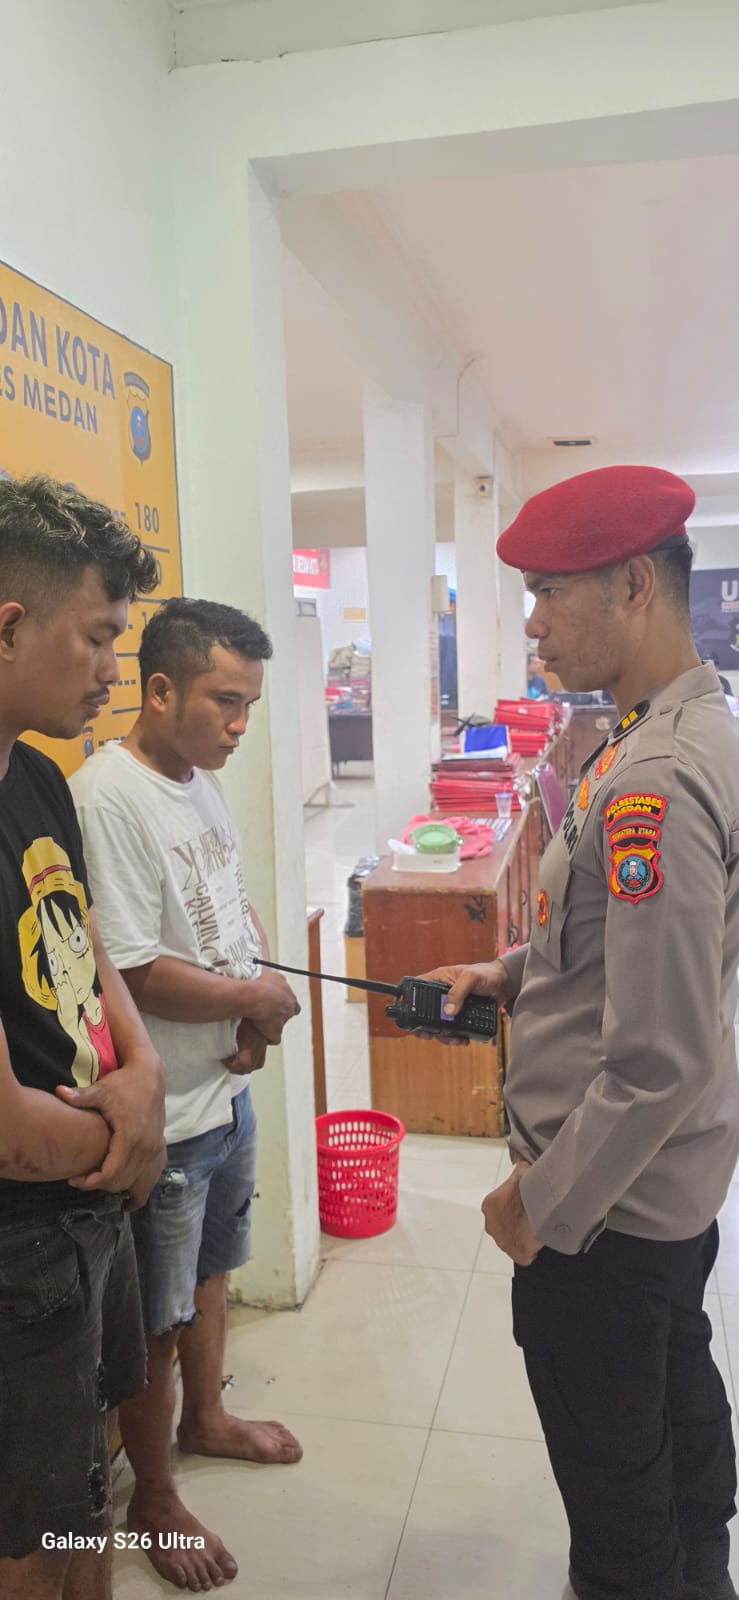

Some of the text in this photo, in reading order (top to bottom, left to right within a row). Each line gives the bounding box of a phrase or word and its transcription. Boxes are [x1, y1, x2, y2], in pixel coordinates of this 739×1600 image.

[56, 323, 116, 400] KOTA
[24, 373, 98, 434] MEDAN
[135, 501, 160, 533] 180
[606, 796, 663, 816] POLRESTABES
[613, 804, 651, 818] MEDAN
[195, 882, 221, 945] CALVIN
